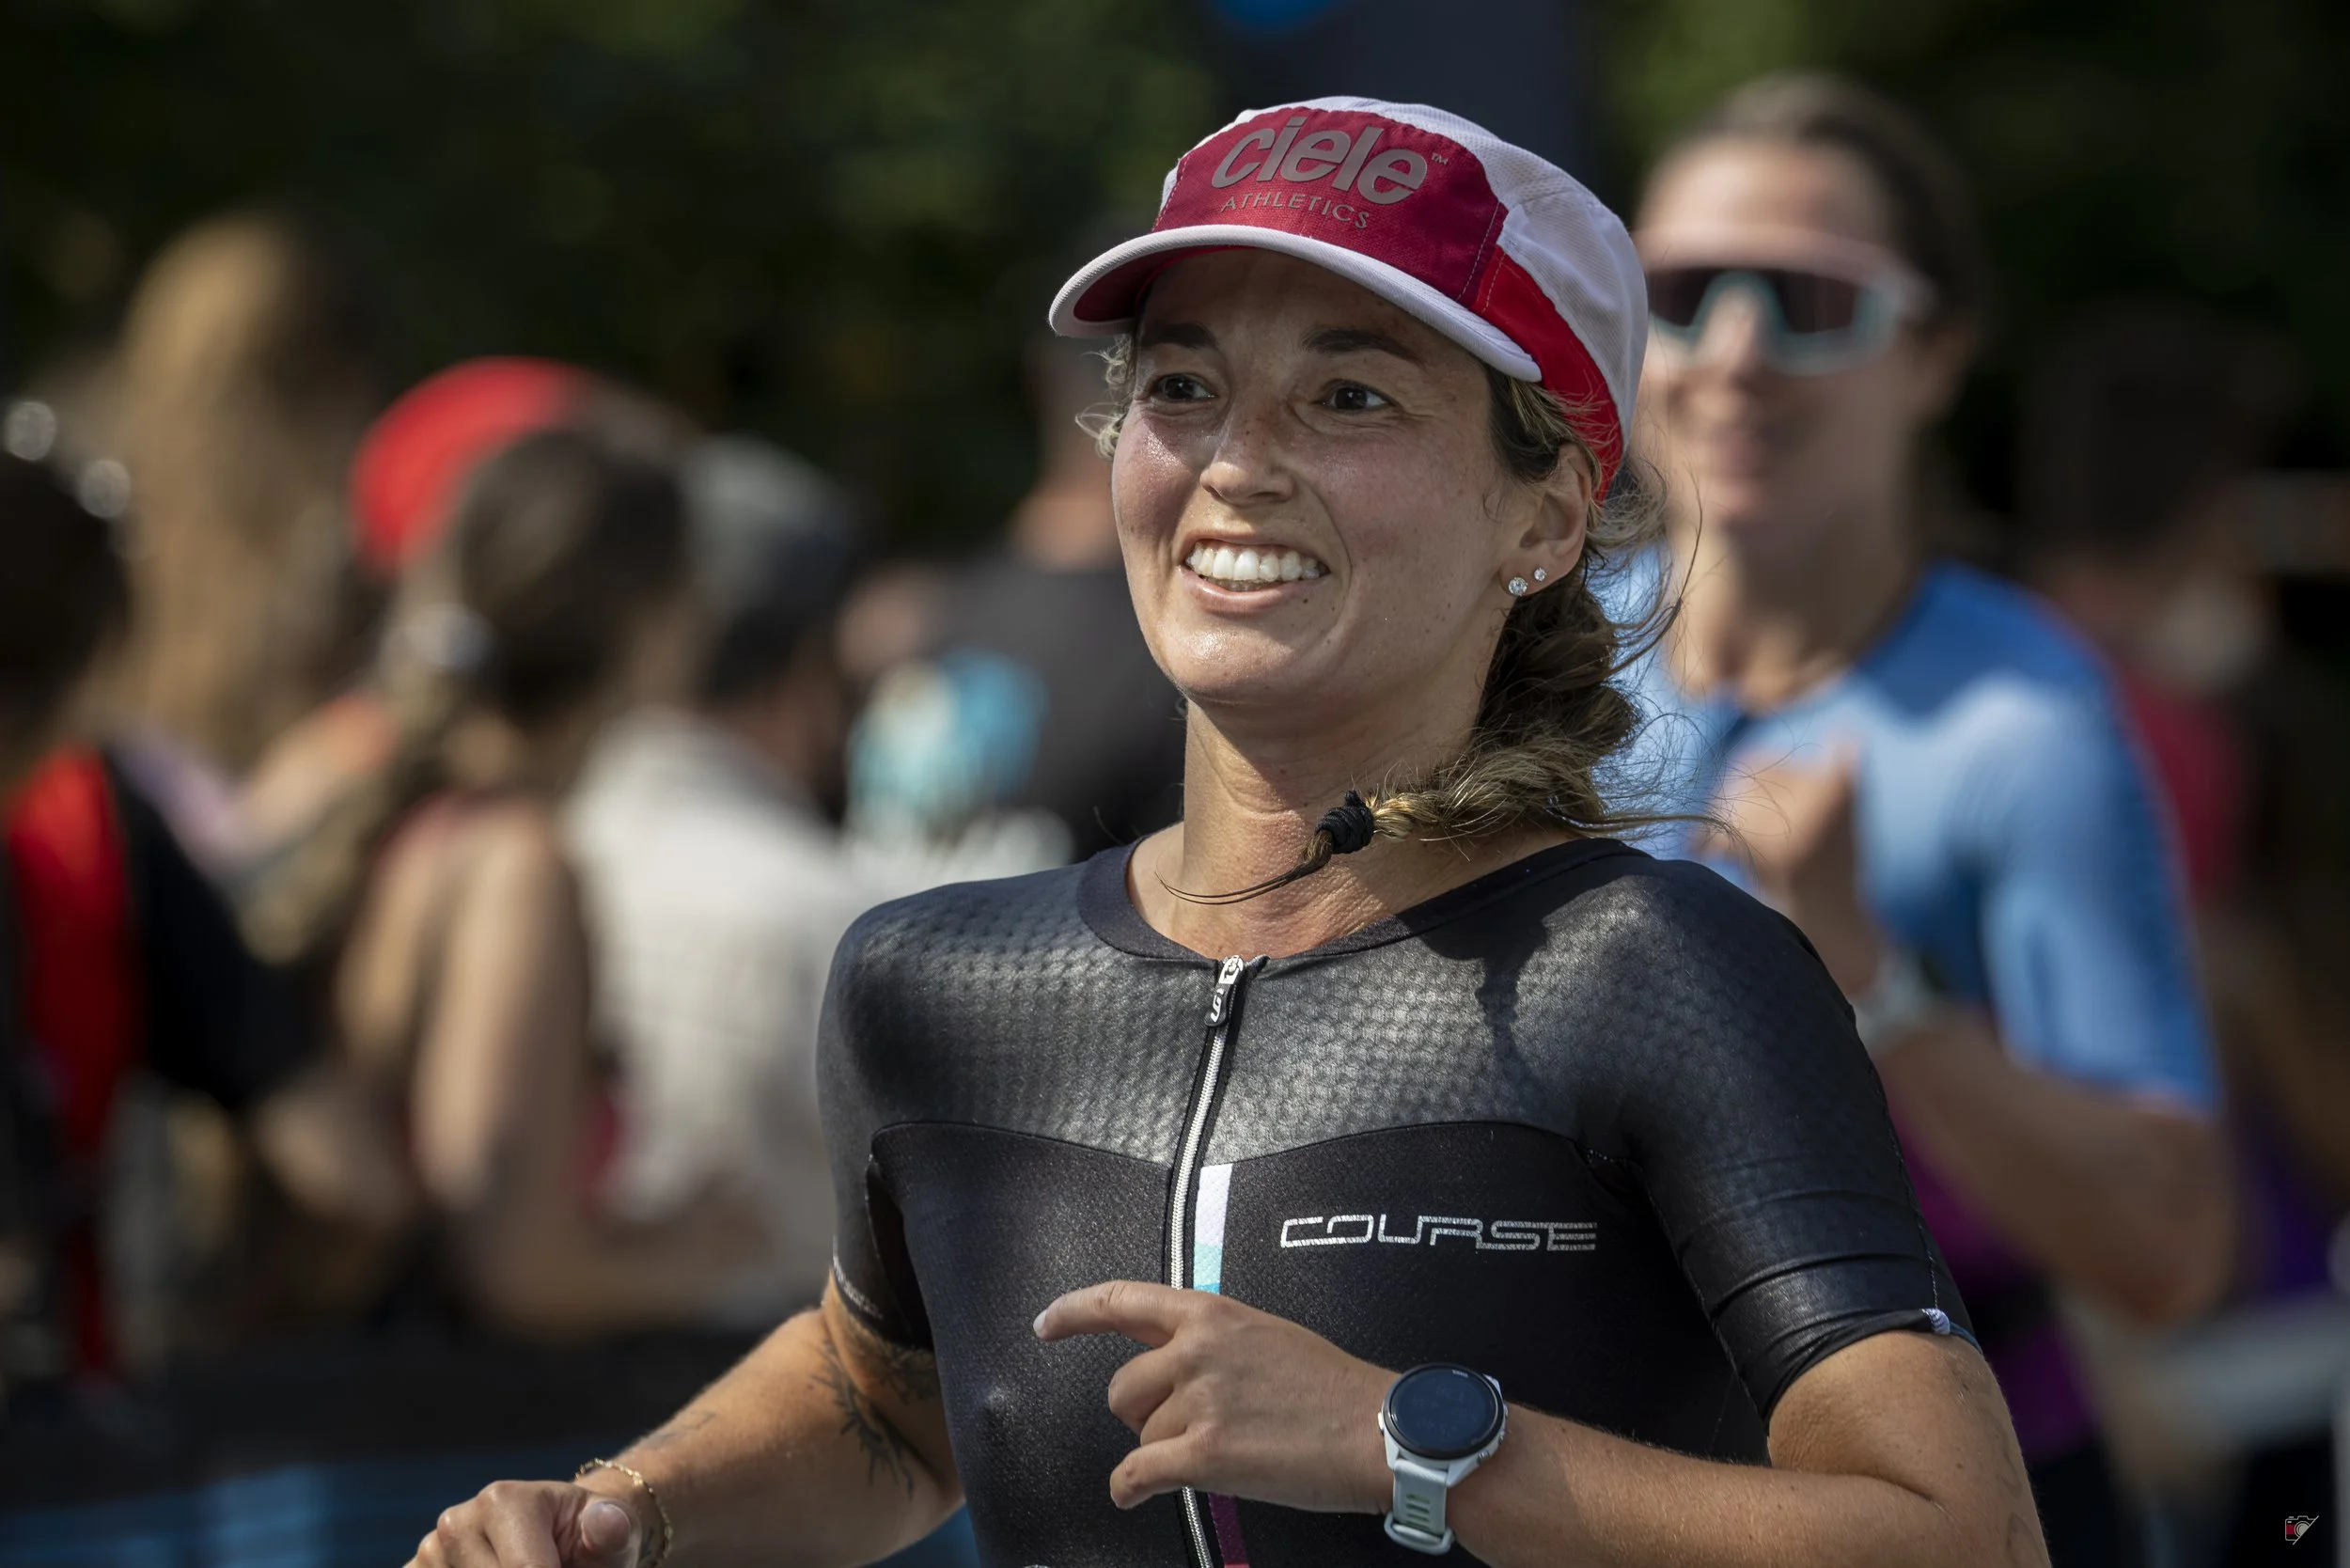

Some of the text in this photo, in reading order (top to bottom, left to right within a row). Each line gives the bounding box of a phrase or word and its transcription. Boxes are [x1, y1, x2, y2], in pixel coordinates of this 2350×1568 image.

[1211, 116, 1428, 205] ciele
[1221, 191, 1370, 229] ATHLETICS
[1280, 1213, 1596, 1251] COURSE
